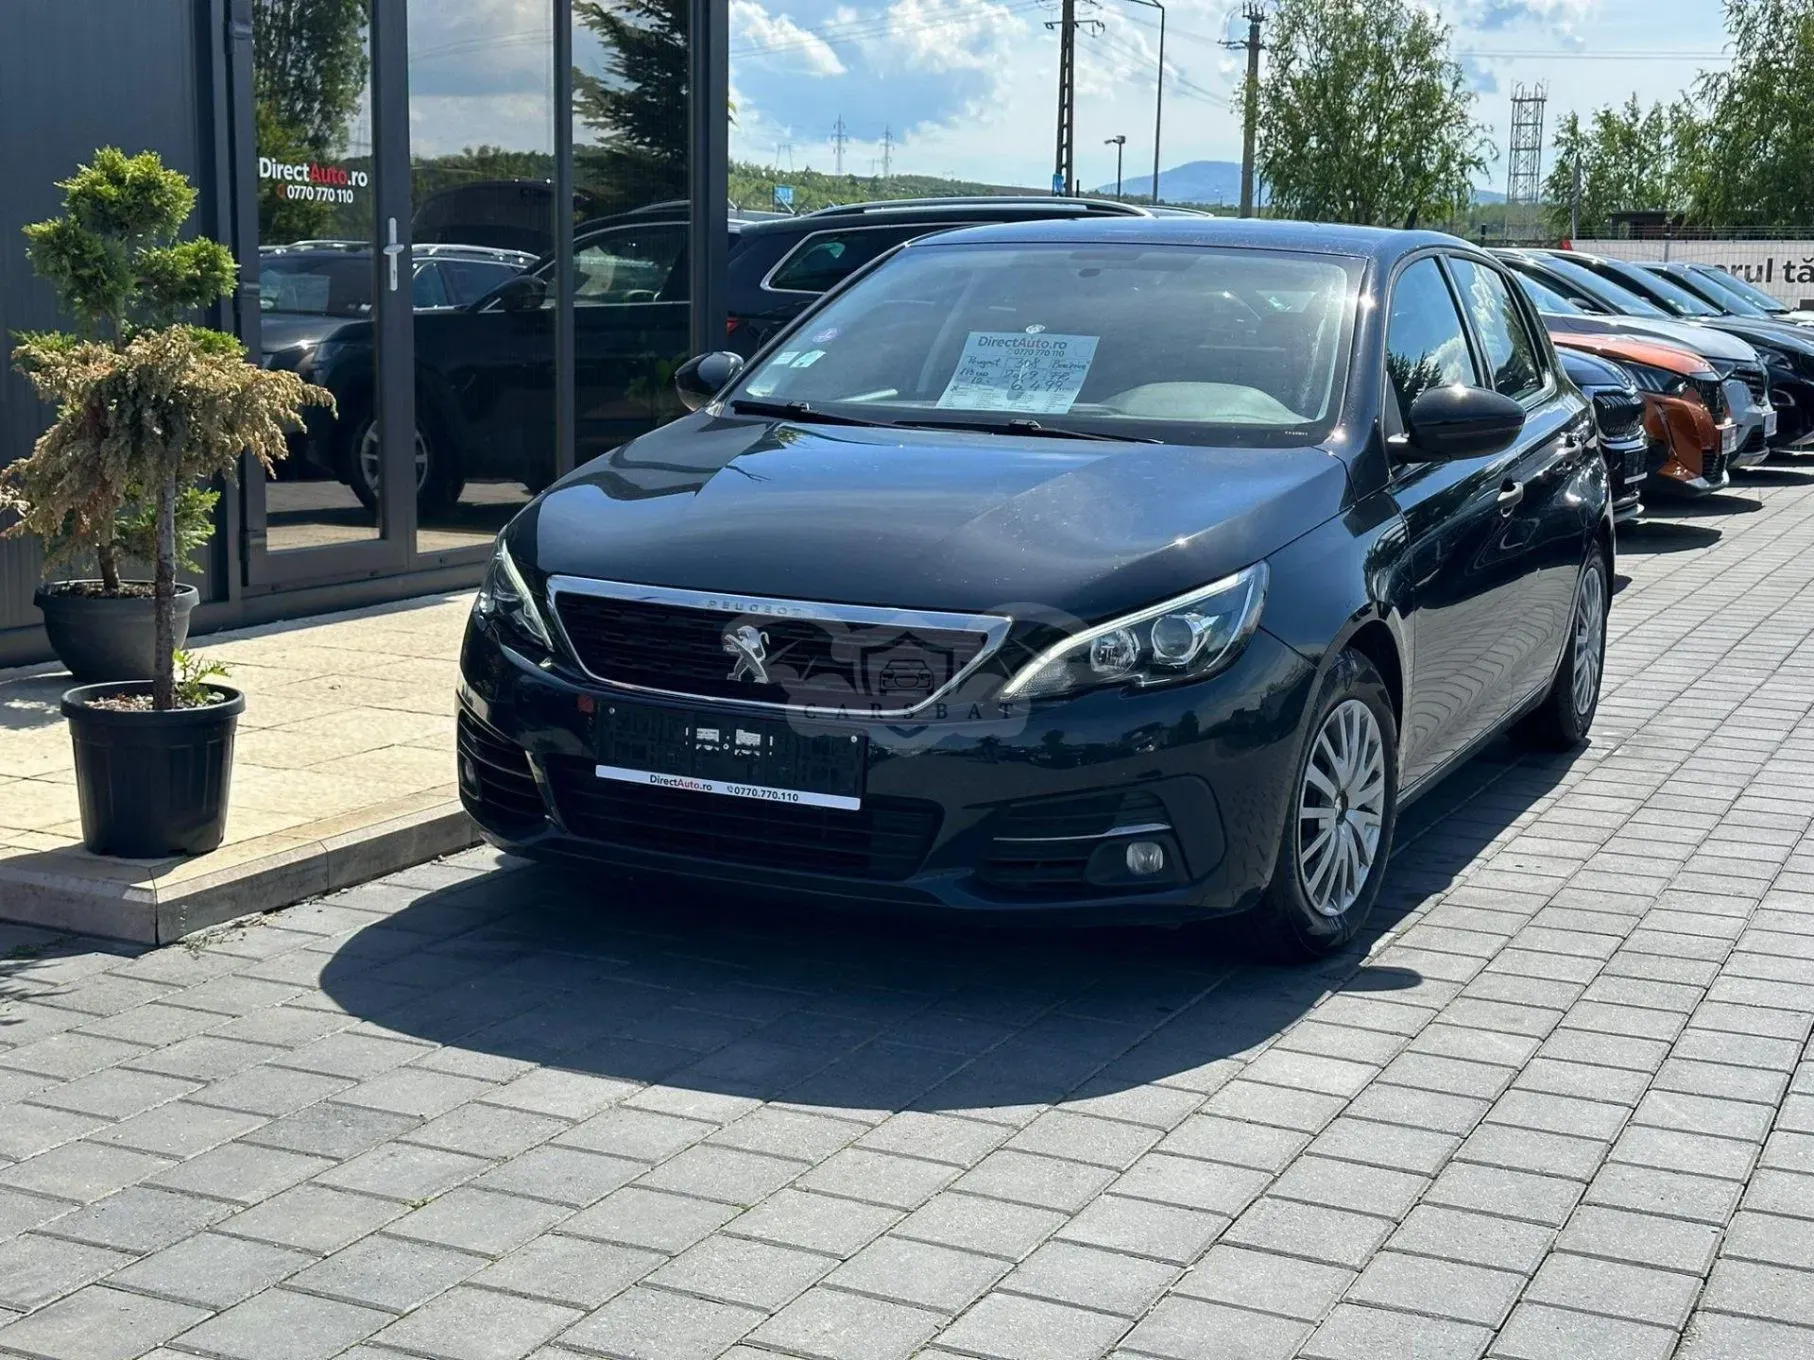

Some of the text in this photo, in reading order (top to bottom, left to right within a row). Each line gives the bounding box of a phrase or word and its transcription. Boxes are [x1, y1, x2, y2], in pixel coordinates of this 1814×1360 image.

[259, 157, 368, 187] DirectAuto.ro
[287, 185, 353, 203] 0770 770 110
[977, 336, 1068, 349] DirectAuto.ro
[1035, 349, 1050, 357] 770
[707, 600, 801, 615] PEUGEOT
[650, 774, 799, 802] DirectAuto.ro 0770.770.110
